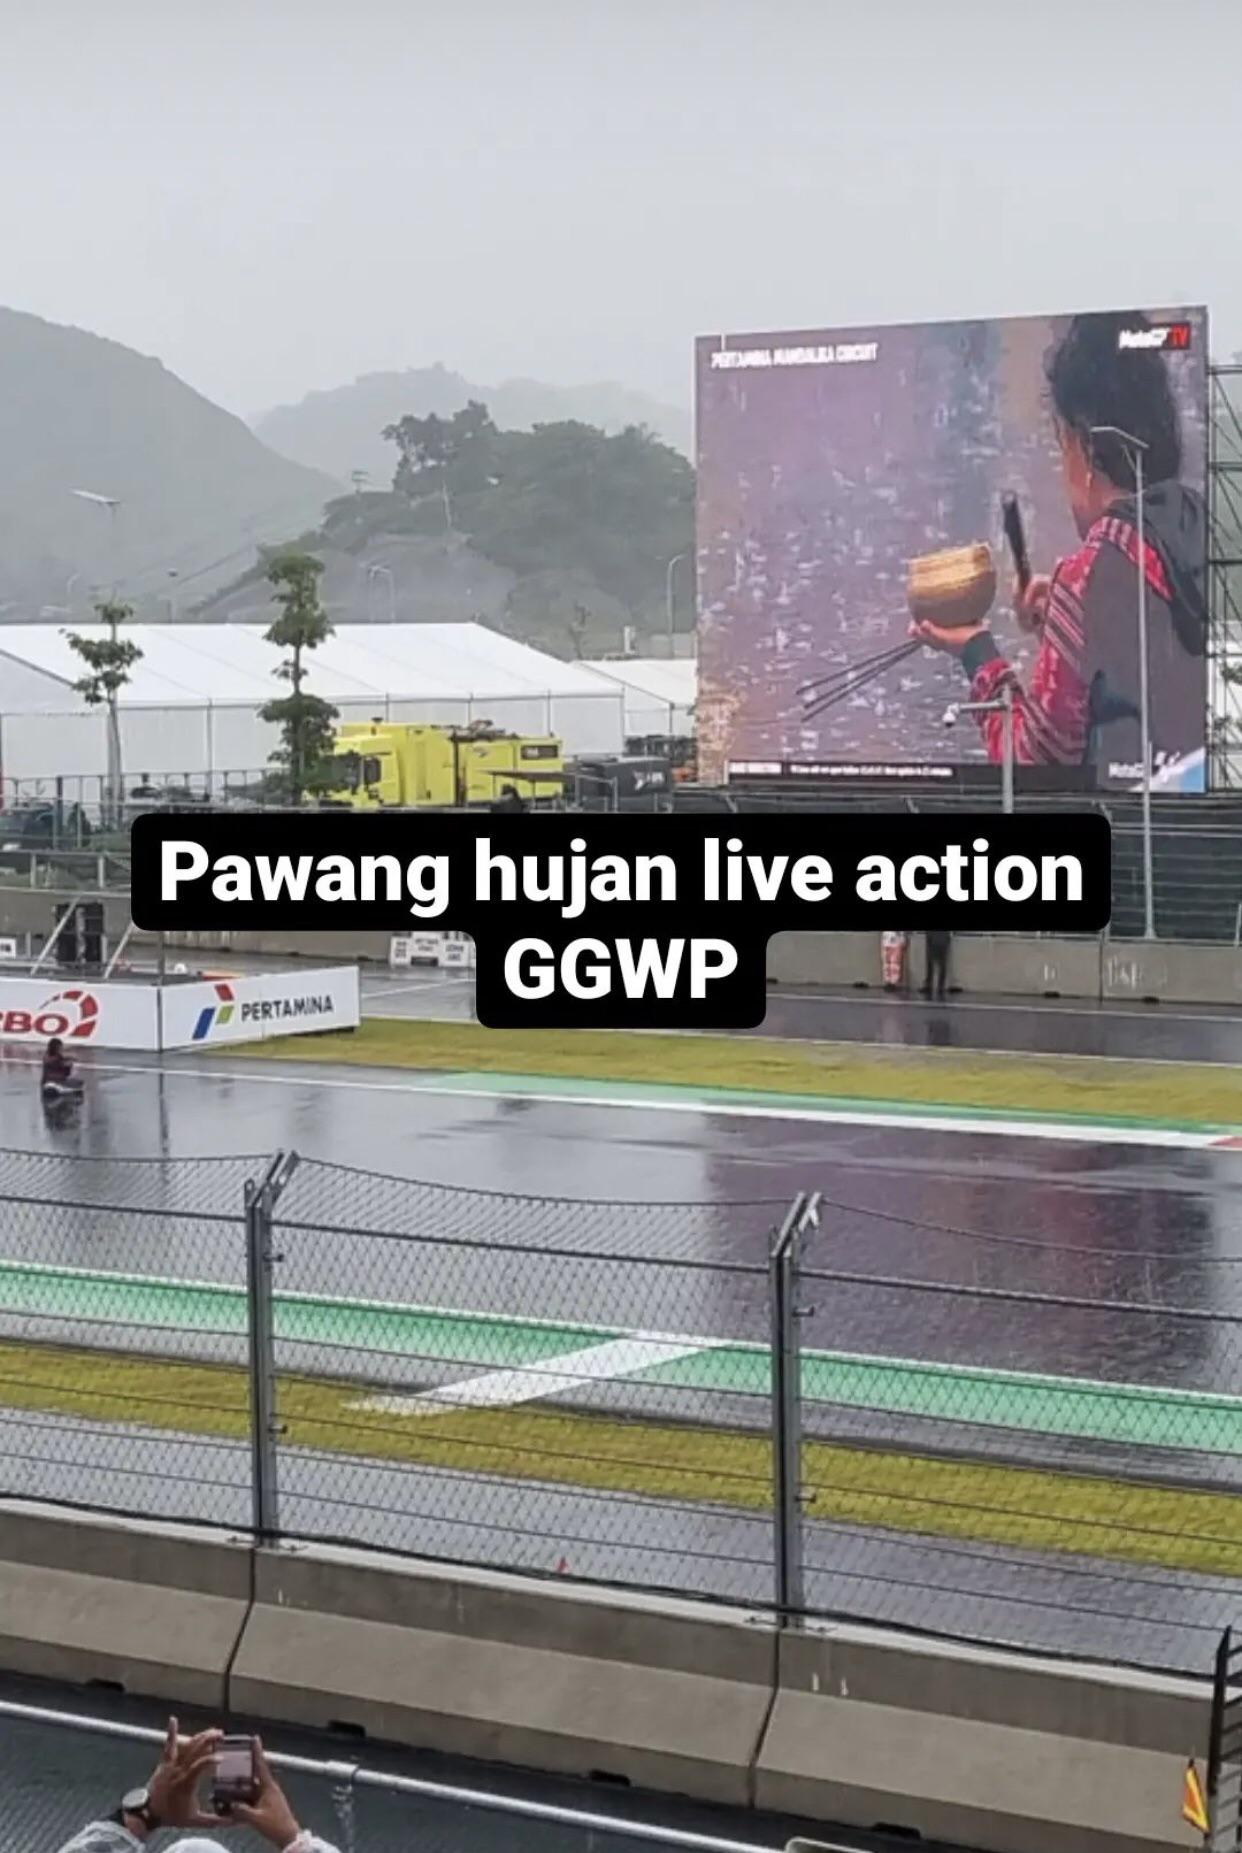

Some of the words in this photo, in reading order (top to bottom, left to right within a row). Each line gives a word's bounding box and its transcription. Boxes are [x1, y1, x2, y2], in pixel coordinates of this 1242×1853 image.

[836, 342, 878, 363] CIRCUIT
[241, 995, 333, 1022] PERTAMINA
[0, 1011, 69, 1036] BO
